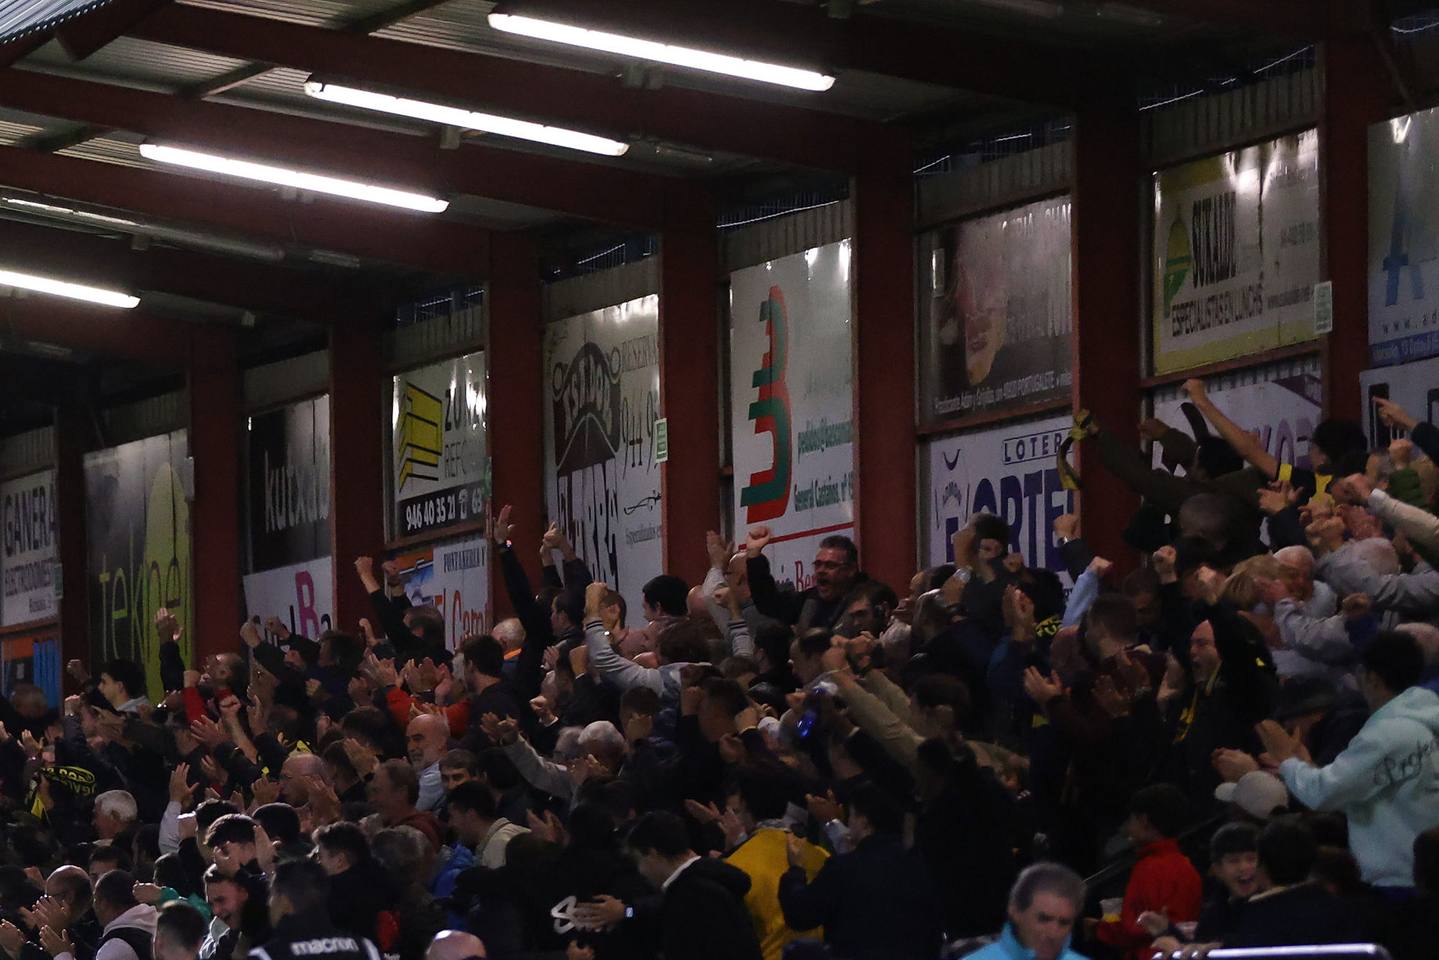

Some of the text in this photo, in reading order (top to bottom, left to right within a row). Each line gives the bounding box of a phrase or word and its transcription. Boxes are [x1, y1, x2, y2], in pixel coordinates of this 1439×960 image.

[1004, 433, 1062, 462] LOTER
[406, 503, 422, 531] 946
[423, 499, 435, 525] 40
[436, 497, 446, 523] 35
[447, 495, 455, 520] 21
[290, 937, 359, 956] macron
